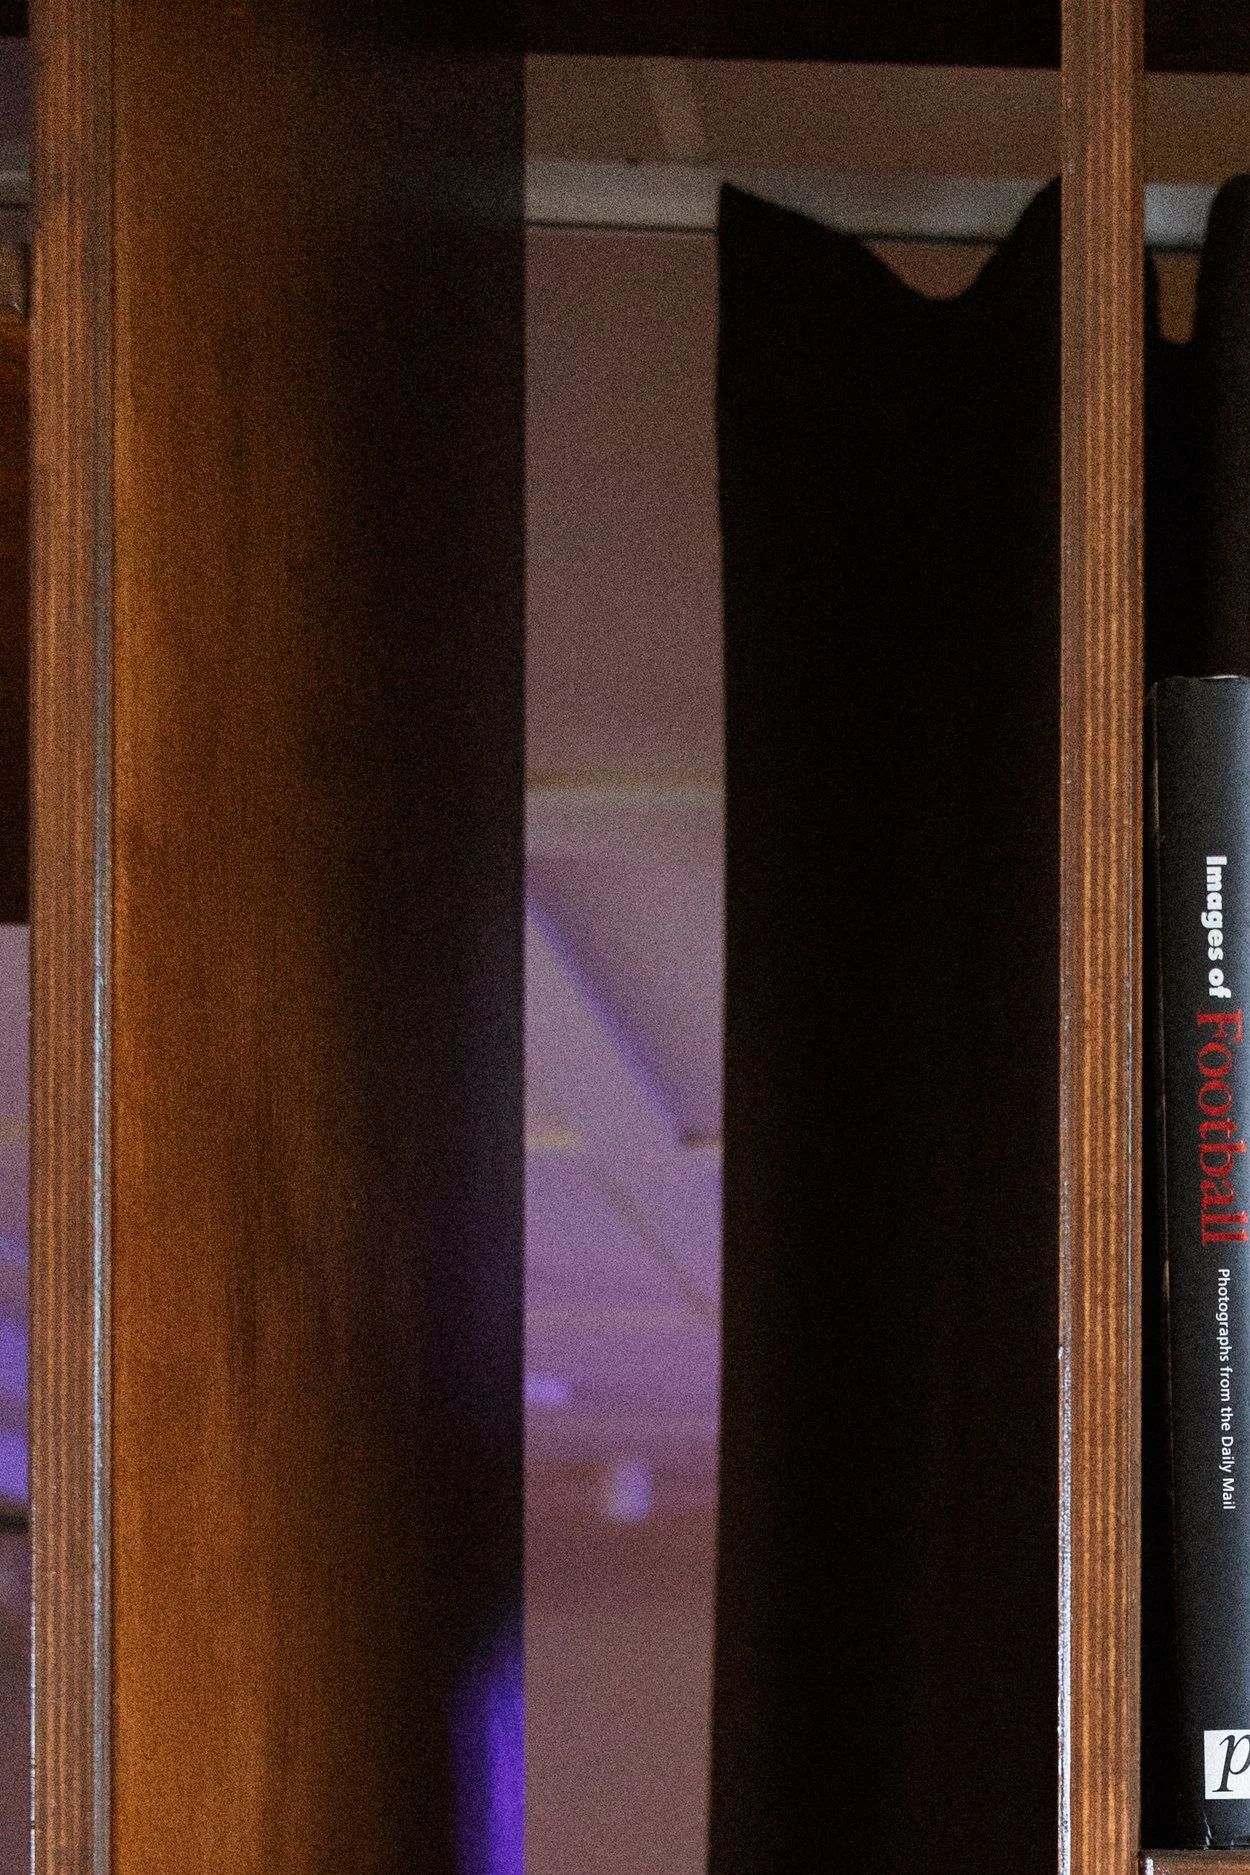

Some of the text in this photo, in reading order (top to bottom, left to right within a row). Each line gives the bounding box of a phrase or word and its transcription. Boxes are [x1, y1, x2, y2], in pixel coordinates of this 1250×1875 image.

[1201, 856, 1231, 999] Images of
[1197, 1008, 1248, 1246] Football
[1216, 1267, 1236, 1511] Photographs from the Daily Mail
